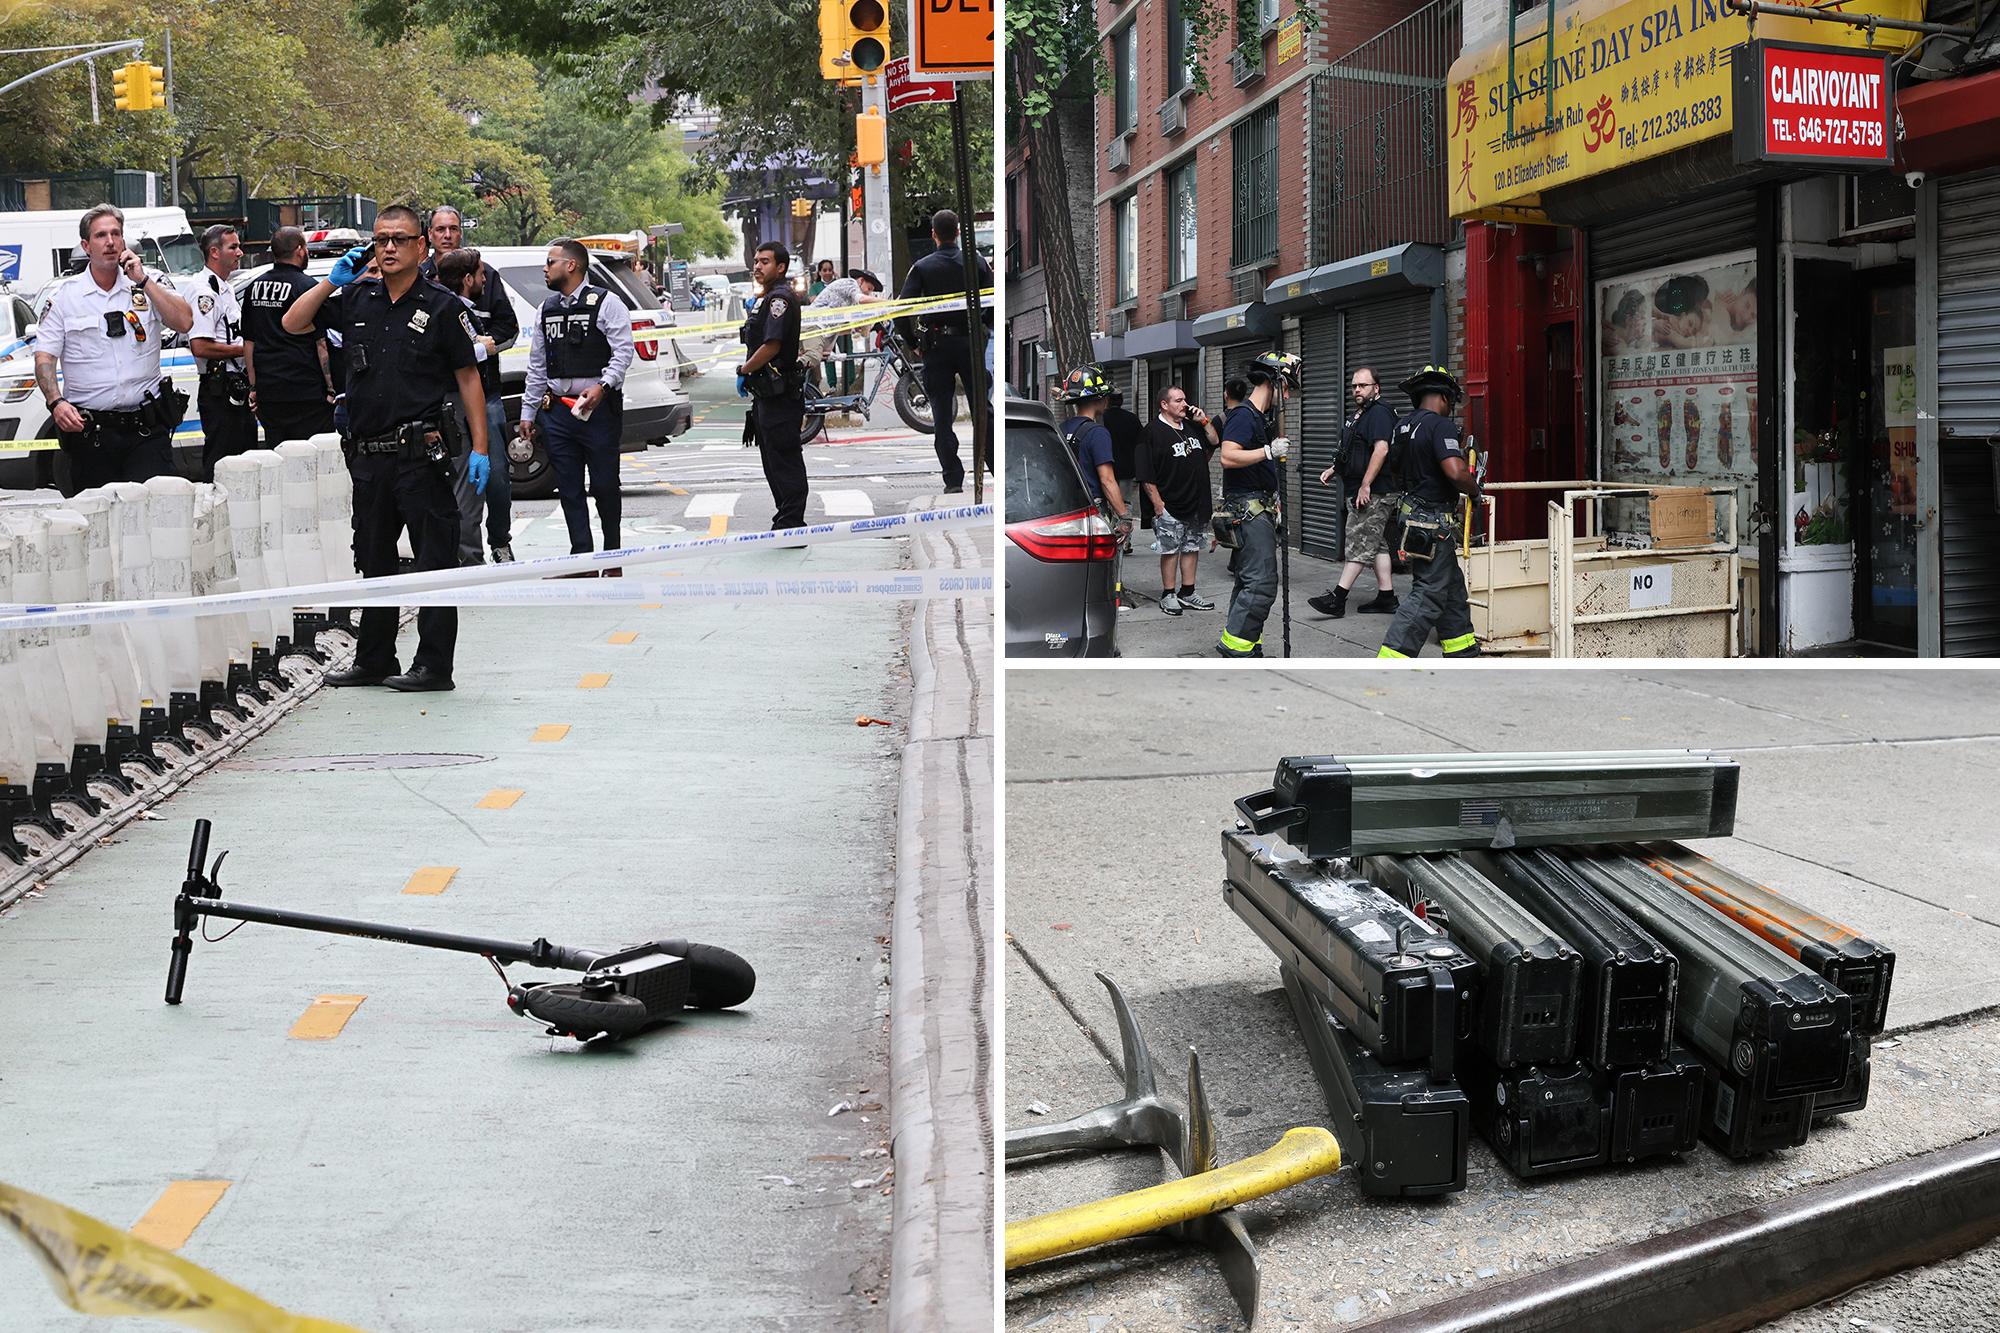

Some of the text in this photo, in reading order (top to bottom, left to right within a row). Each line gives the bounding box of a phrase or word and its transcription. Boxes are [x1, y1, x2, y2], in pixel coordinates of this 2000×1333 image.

[1489, 75, 1523, 117] SUN
[1591, 24, 1634, 74] DAY
[1640, 4, 1683, 53] SPA
[887, 68, 897, 77] NO
[1771, 65, 1880, 109] CLAIRVOYANT
[1566, 103, 1583, 128] Rub
[1618, 95, 1722, 149] Tel: 212.334.8383
[1452, 80, 1479, 202] 陽光
[1772, 116, 1883, 147] TEL: 646-727-5758
[1514, 158, 1545, 185] Elizabeth
[1546, 151, 1570, 175] Street.
[250, 280, 292, 302] NYPD
[545, 321, 589, 339] POLIE
[1071, 370, 1082, 383] 8
[1692, 366, 1713, 374] ZONES
[1713, 365, 1738, 373] HEALTH
[1887, 364, 1902, 376] 120
[1658, 507, 1675, 529] No
[1633, 574, 1653, 590] NO
